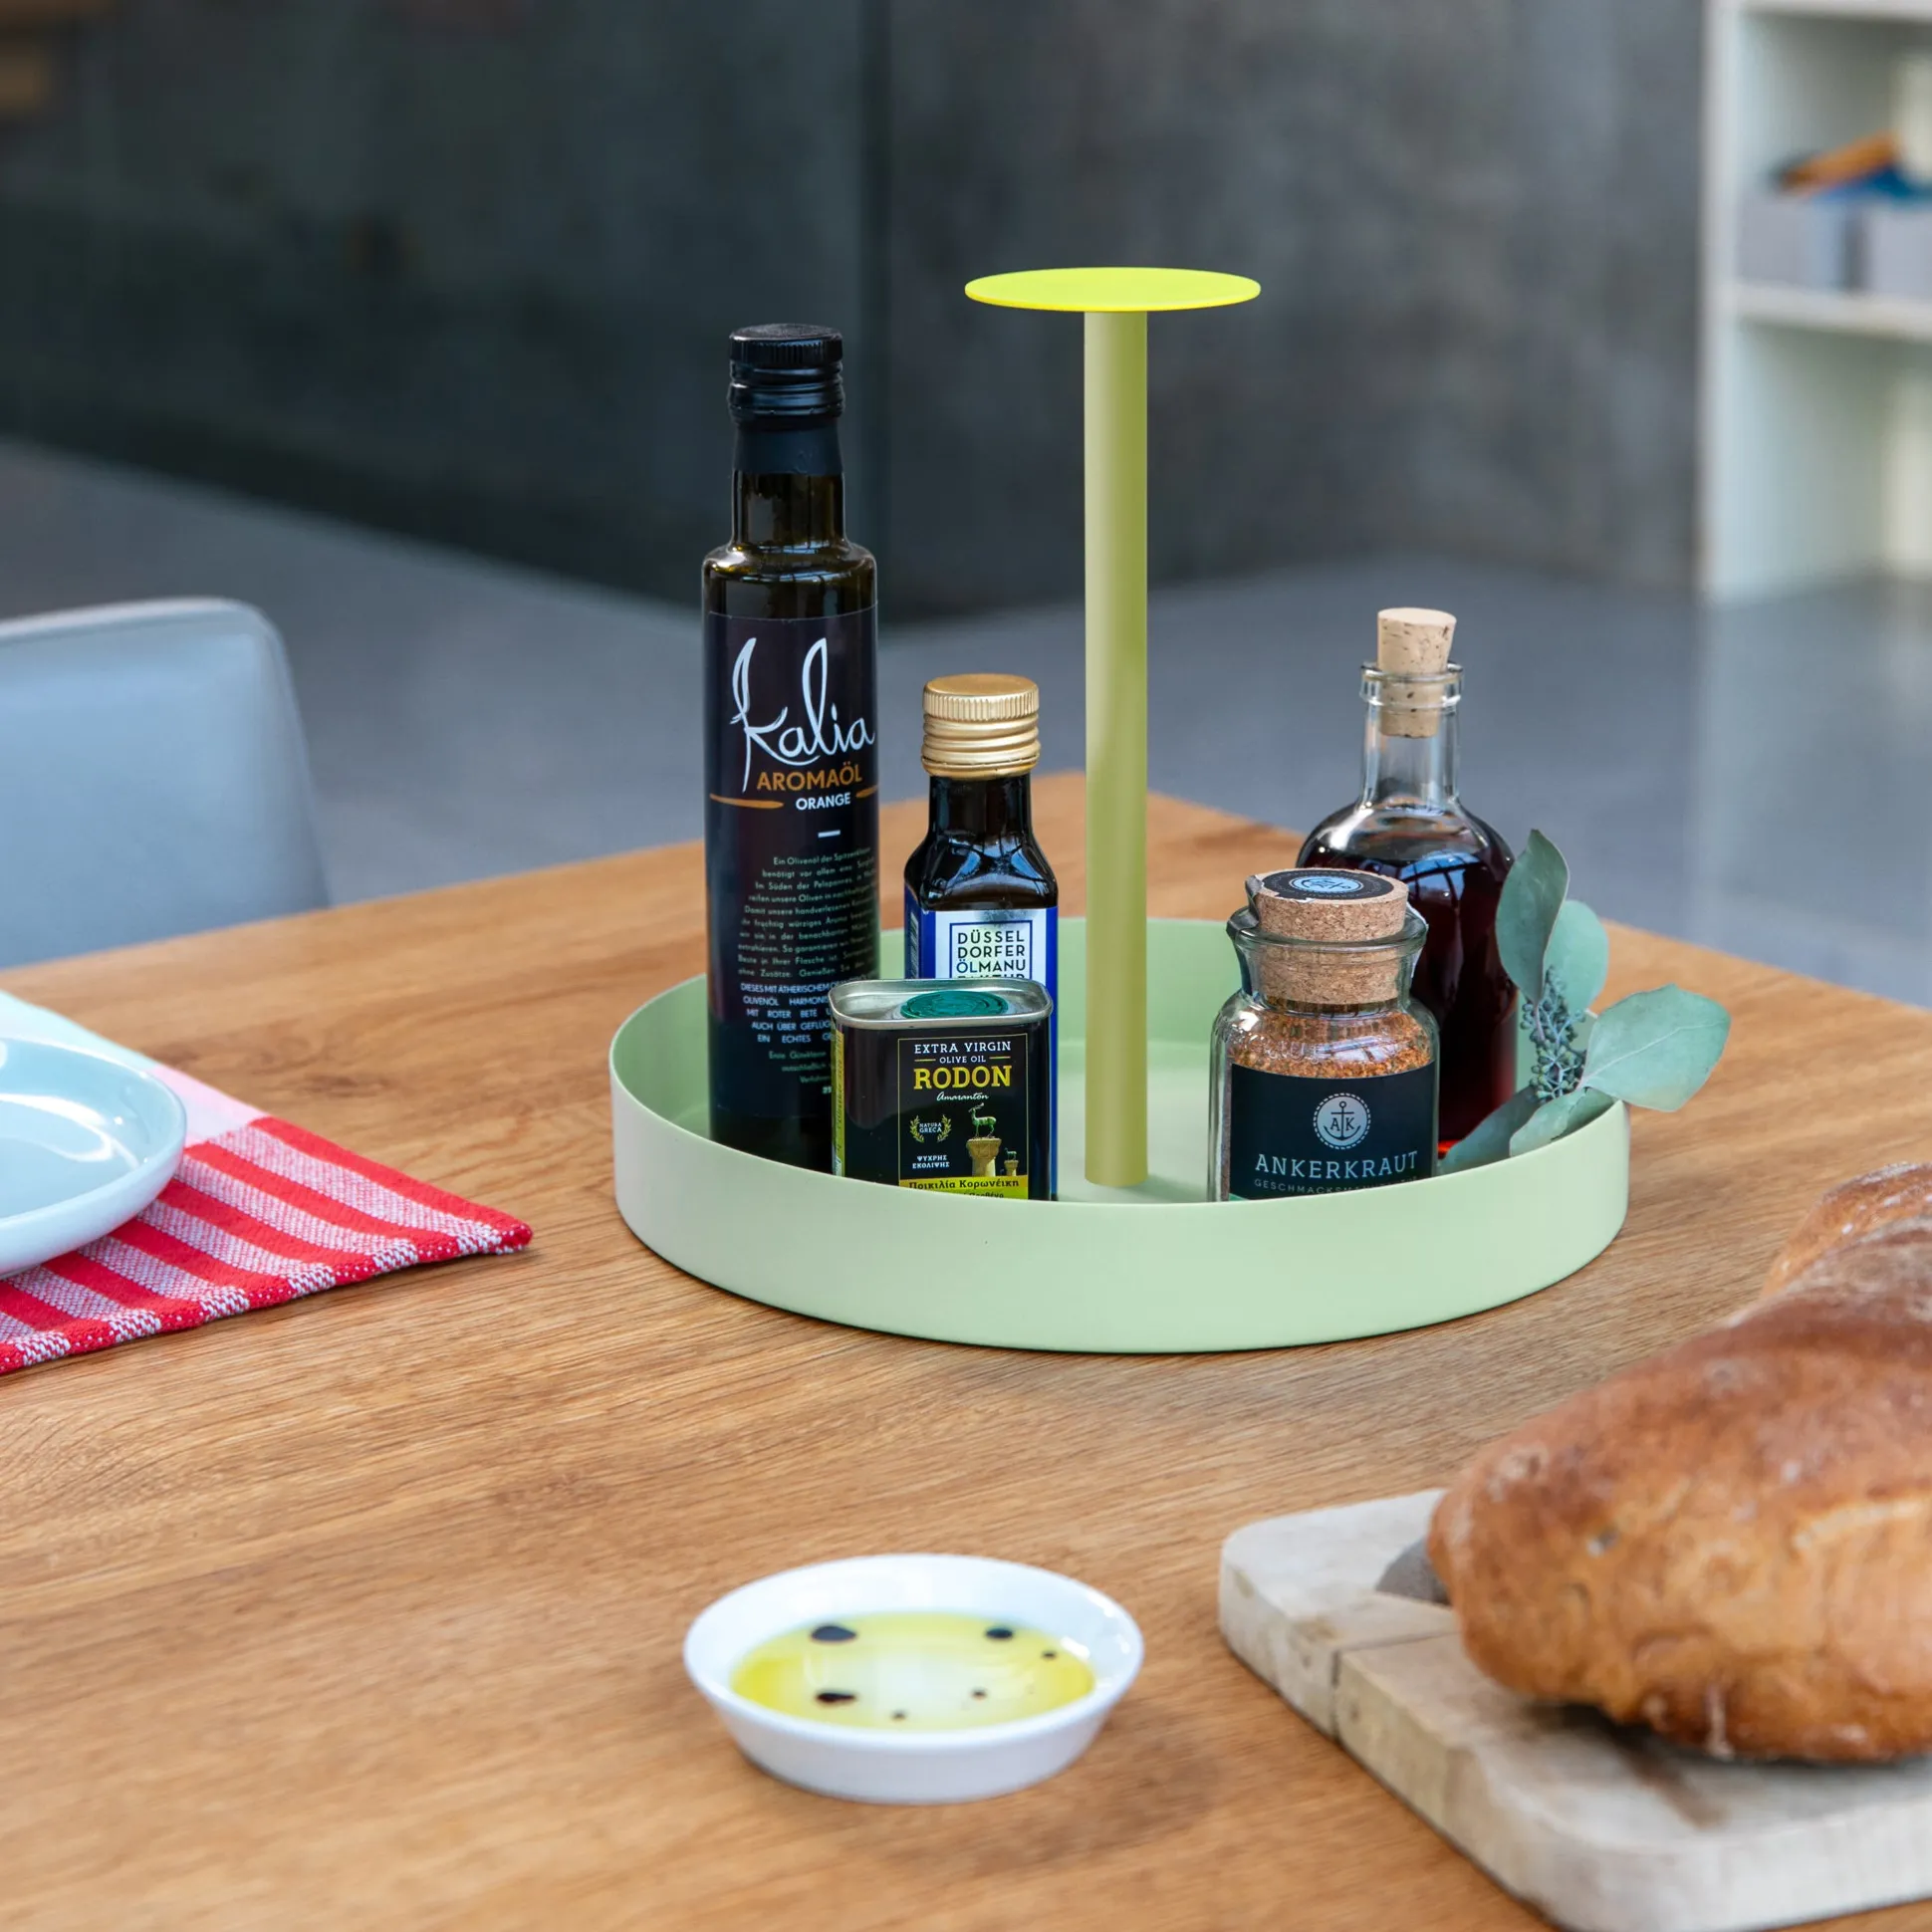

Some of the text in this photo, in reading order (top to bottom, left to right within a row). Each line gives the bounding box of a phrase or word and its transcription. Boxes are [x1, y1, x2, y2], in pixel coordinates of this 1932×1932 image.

[757, 762, 862, 791] AROMAÖL
[796, 793, 851, 810] ORANGE
[958, 929, 1025, 945] DÜSSEL
[958, 945, 1025, 958] DORFER
[956, 959, 1026, 974] ÖLMANU
[740, 982, 764, 993] DIESES
[746, 1008, 759, 1017] MIT
[751, 1022, 774, 1031] AUCH
[757, 1034, 771, 1044] EIN
[914, 1041, 1011, 1054] EXTRA VIRGIN
[939, 1056, 967, 1065] OLIVE
[913, 1065, 1012, 1089] RODON
[1255, 1150, 1418, 1179] ANKERKRAUT
